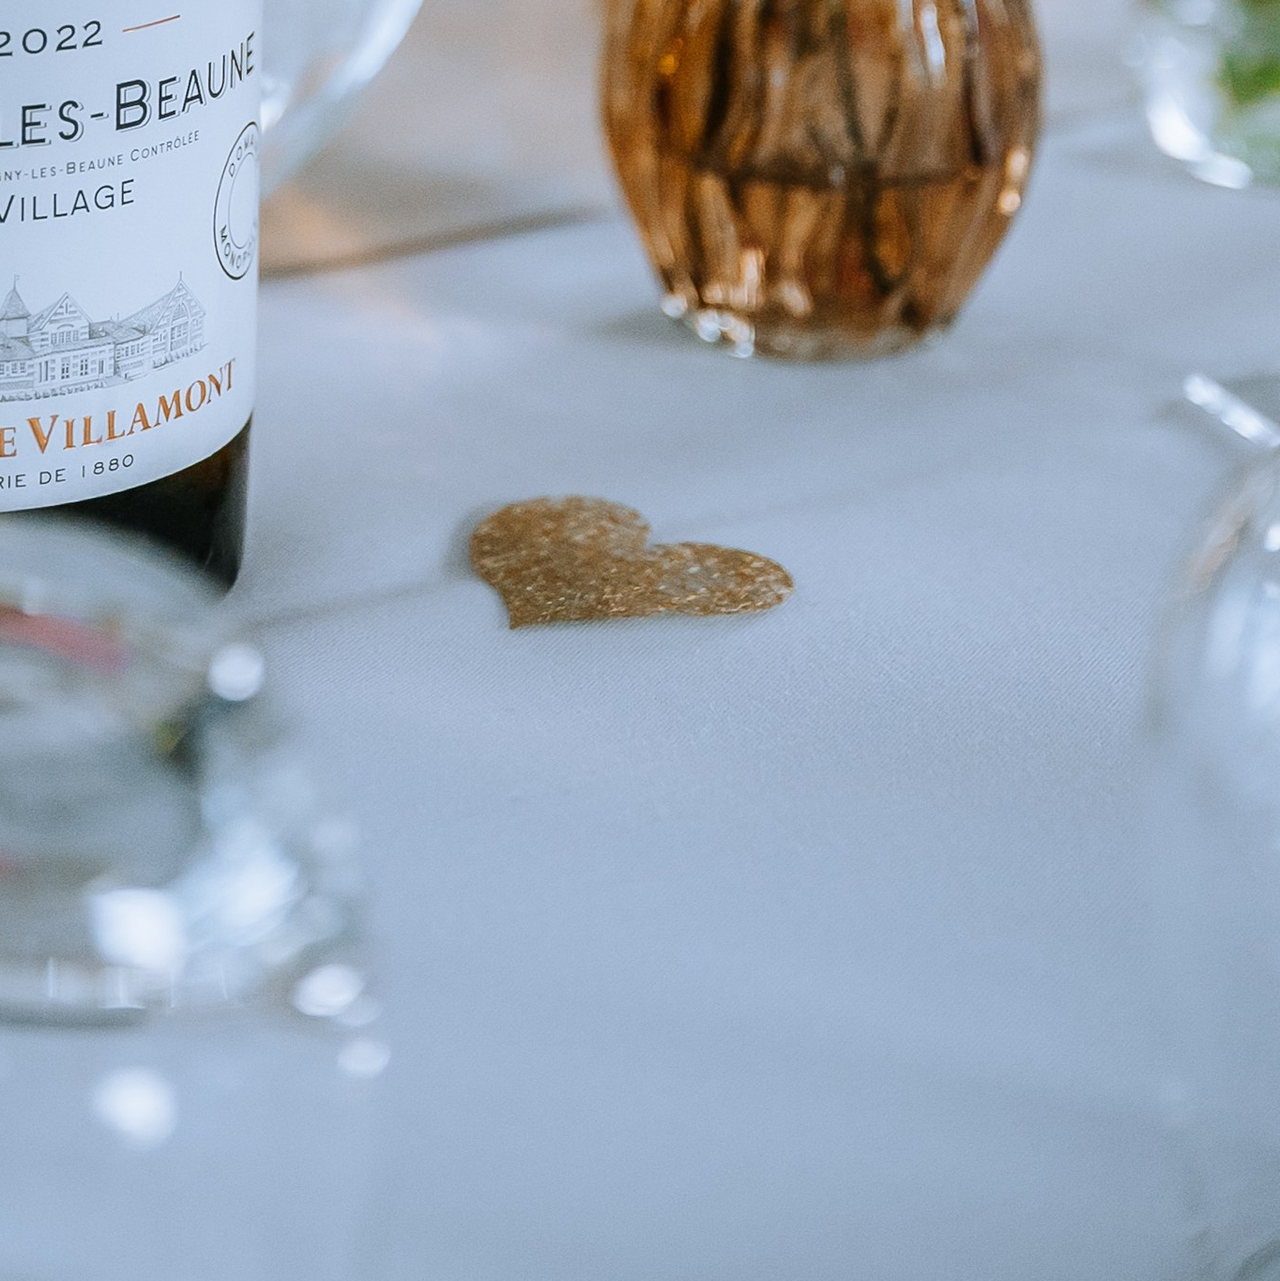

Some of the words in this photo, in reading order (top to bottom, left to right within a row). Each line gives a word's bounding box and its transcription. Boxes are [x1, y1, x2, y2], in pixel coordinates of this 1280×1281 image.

[26, 356, 237, 455] VILLAMONT
[38, 467, 67, 486] DE
[81, 452, 136, 479] 1880
